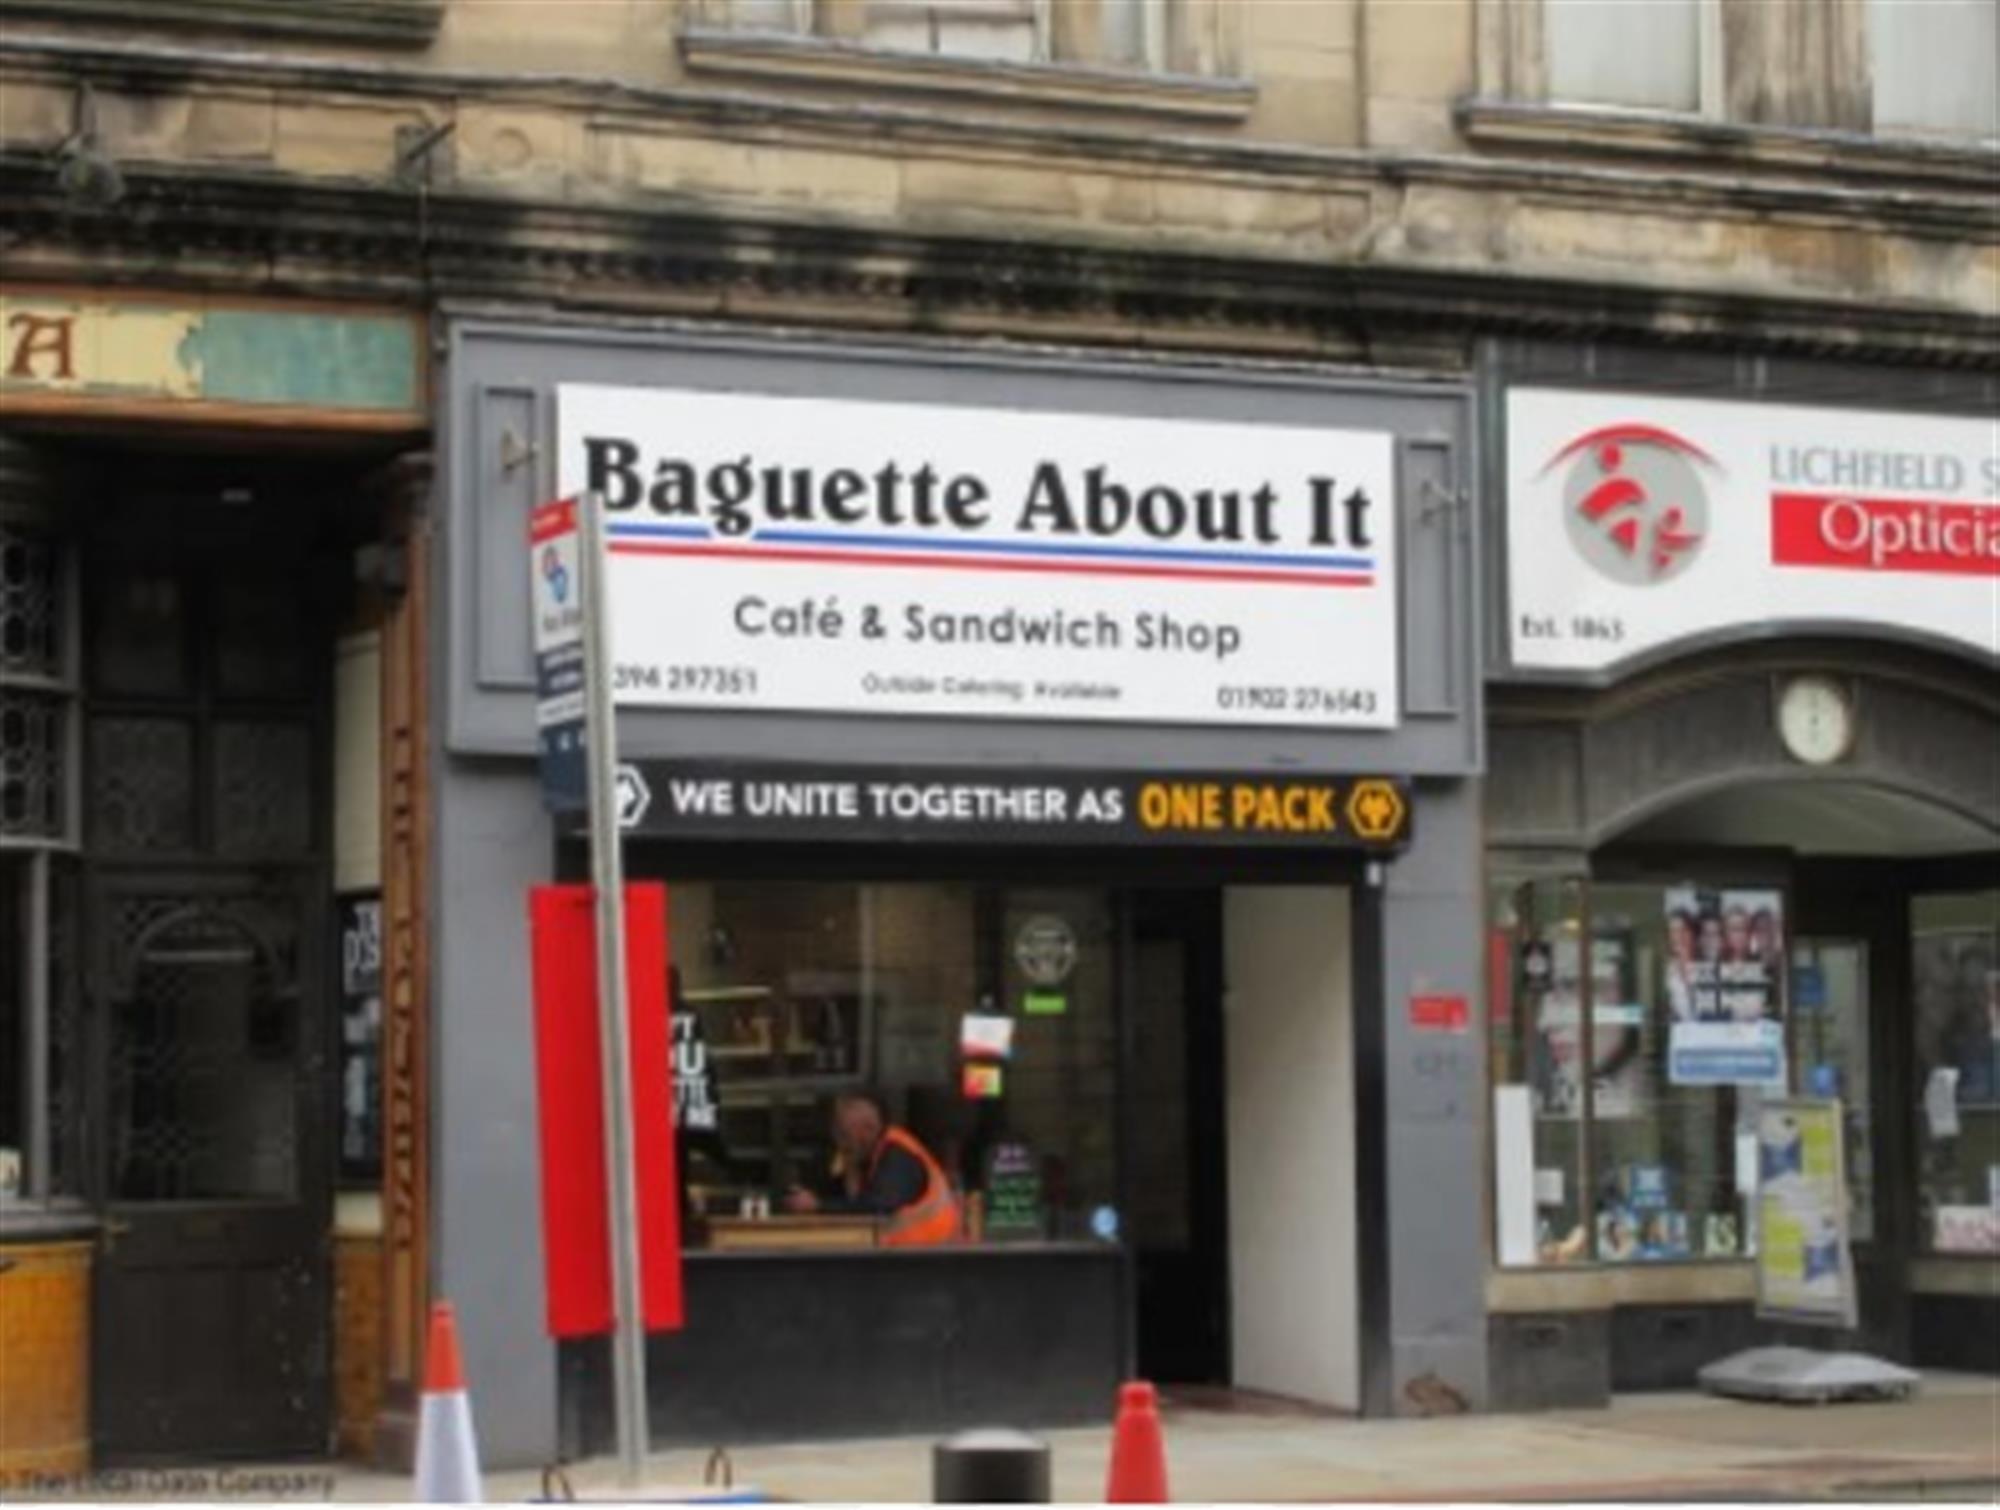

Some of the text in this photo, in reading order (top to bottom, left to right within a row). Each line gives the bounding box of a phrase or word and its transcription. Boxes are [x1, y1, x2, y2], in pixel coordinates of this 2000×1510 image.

[8, 313, 76, 379] A
[583, 437, 1372, 548] Baguette About It
[1769, 446, 1964, 492] LICHFIELD
[733, 596, 1241, 658] Café & Sandwich Shop
[671, 781, 1336, 831] WE UNITE TOGETHER AS ONE PACK
